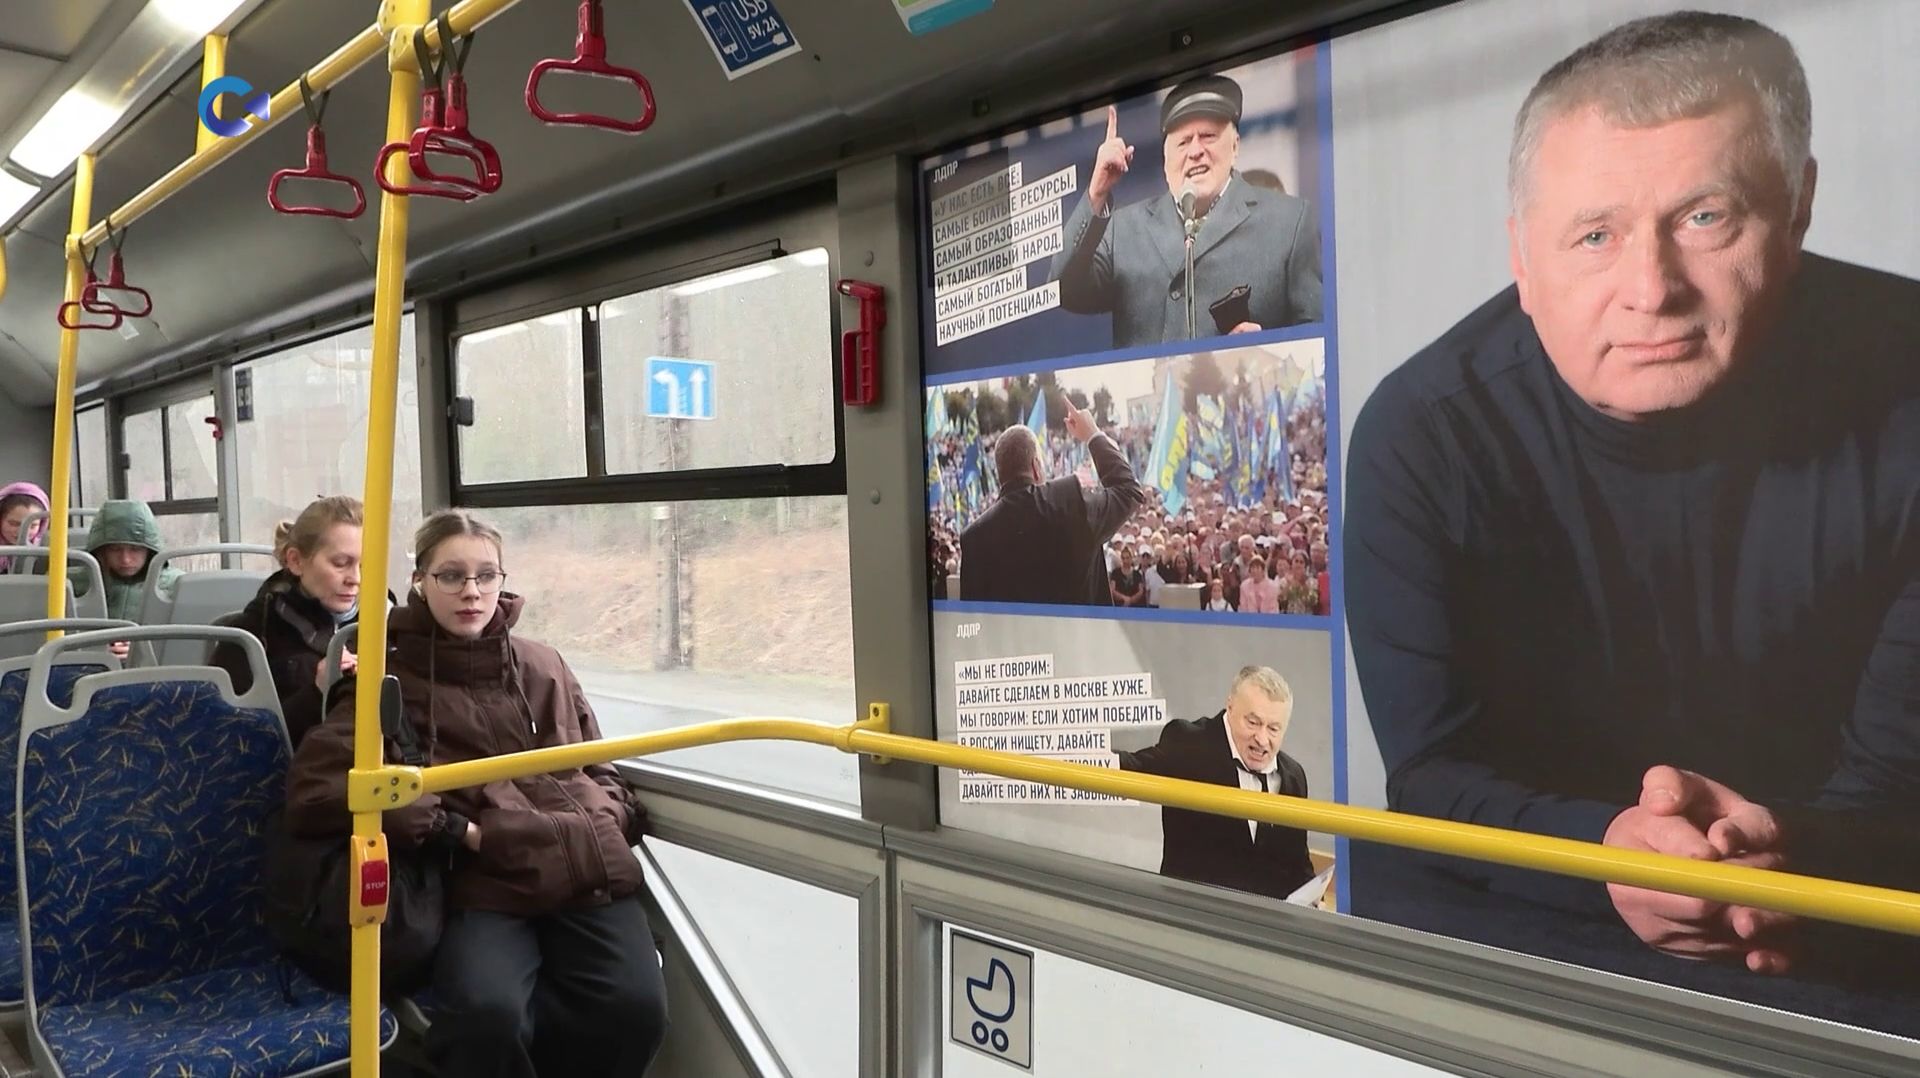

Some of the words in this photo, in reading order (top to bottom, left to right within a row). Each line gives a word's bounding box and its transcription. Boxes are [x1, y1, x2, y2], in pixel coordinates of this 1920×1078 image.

[934, 160, 958, 183] ЛДПР
[934, 200, 946, 217] «У
[950, 192, 967, 213] НАС
[971, 181, 994, 203] ЕСТЬ
[935, 218, 970, 244] САМЫЕ
[973, 196, 1016, 228] БОГАТЫЕ
[936, 238, 972, 268] САМЫЙ
[975, 202, 1059, 251] ОБРАЗОВАННЫЙ
[937, 278, 944, 291] И
[948, 246, 1019, 287] ТАЛАНТЛИВЫЙ
[938, 290, 974, 316] САМЫЙ
[977, 270, 1023, 300] БОГАТЫЙ
[939, 312, 985, 340] НАУЧНЫЙ
[989, 288, 1056, 323] ПОТЕНЦИАЛ»
[957, 622, 981, 639] ЛДПР
[958, 665, 981, 680] «МЫ
[985, 664, 996, 679] НЕ
[1000, 660, 1050, 678] ГОВОРИМ:
[959, 686, 1000, 706] ДАВАЙТЕ
[1004, 685, 1050, 703] СДЕЛАЕМ
[1054, 683, 1060, 699] В
[1064, 681, 1108, 698] МОСКВЕ
[1112, 679, 1148, 696] ХУЖЕ.
[960, 713, 976, 727] МЫ
[980, 710, 1029, 727] ГОВОРИМ:
[1032, 709, 1058, 725] ЕСЛИ
[1062, 707, 1098, 724] ХОТИМ
[1103, 705, 1163, 724] ПОБЕДИТЬ
[970, 736, 1007, 750] РОССИИ
[1057, 731, 1105, 750] ДАВАЙТЕ
[962, 781, 1003, 800] ДАВАЙТЕ
[1008, 784, 1026, 799] ПРО
[1031, 784, 1051, 799] НИХ
[1055, 786, 1067, 799] НЕ
[366, 881, 386, 890] STOP
